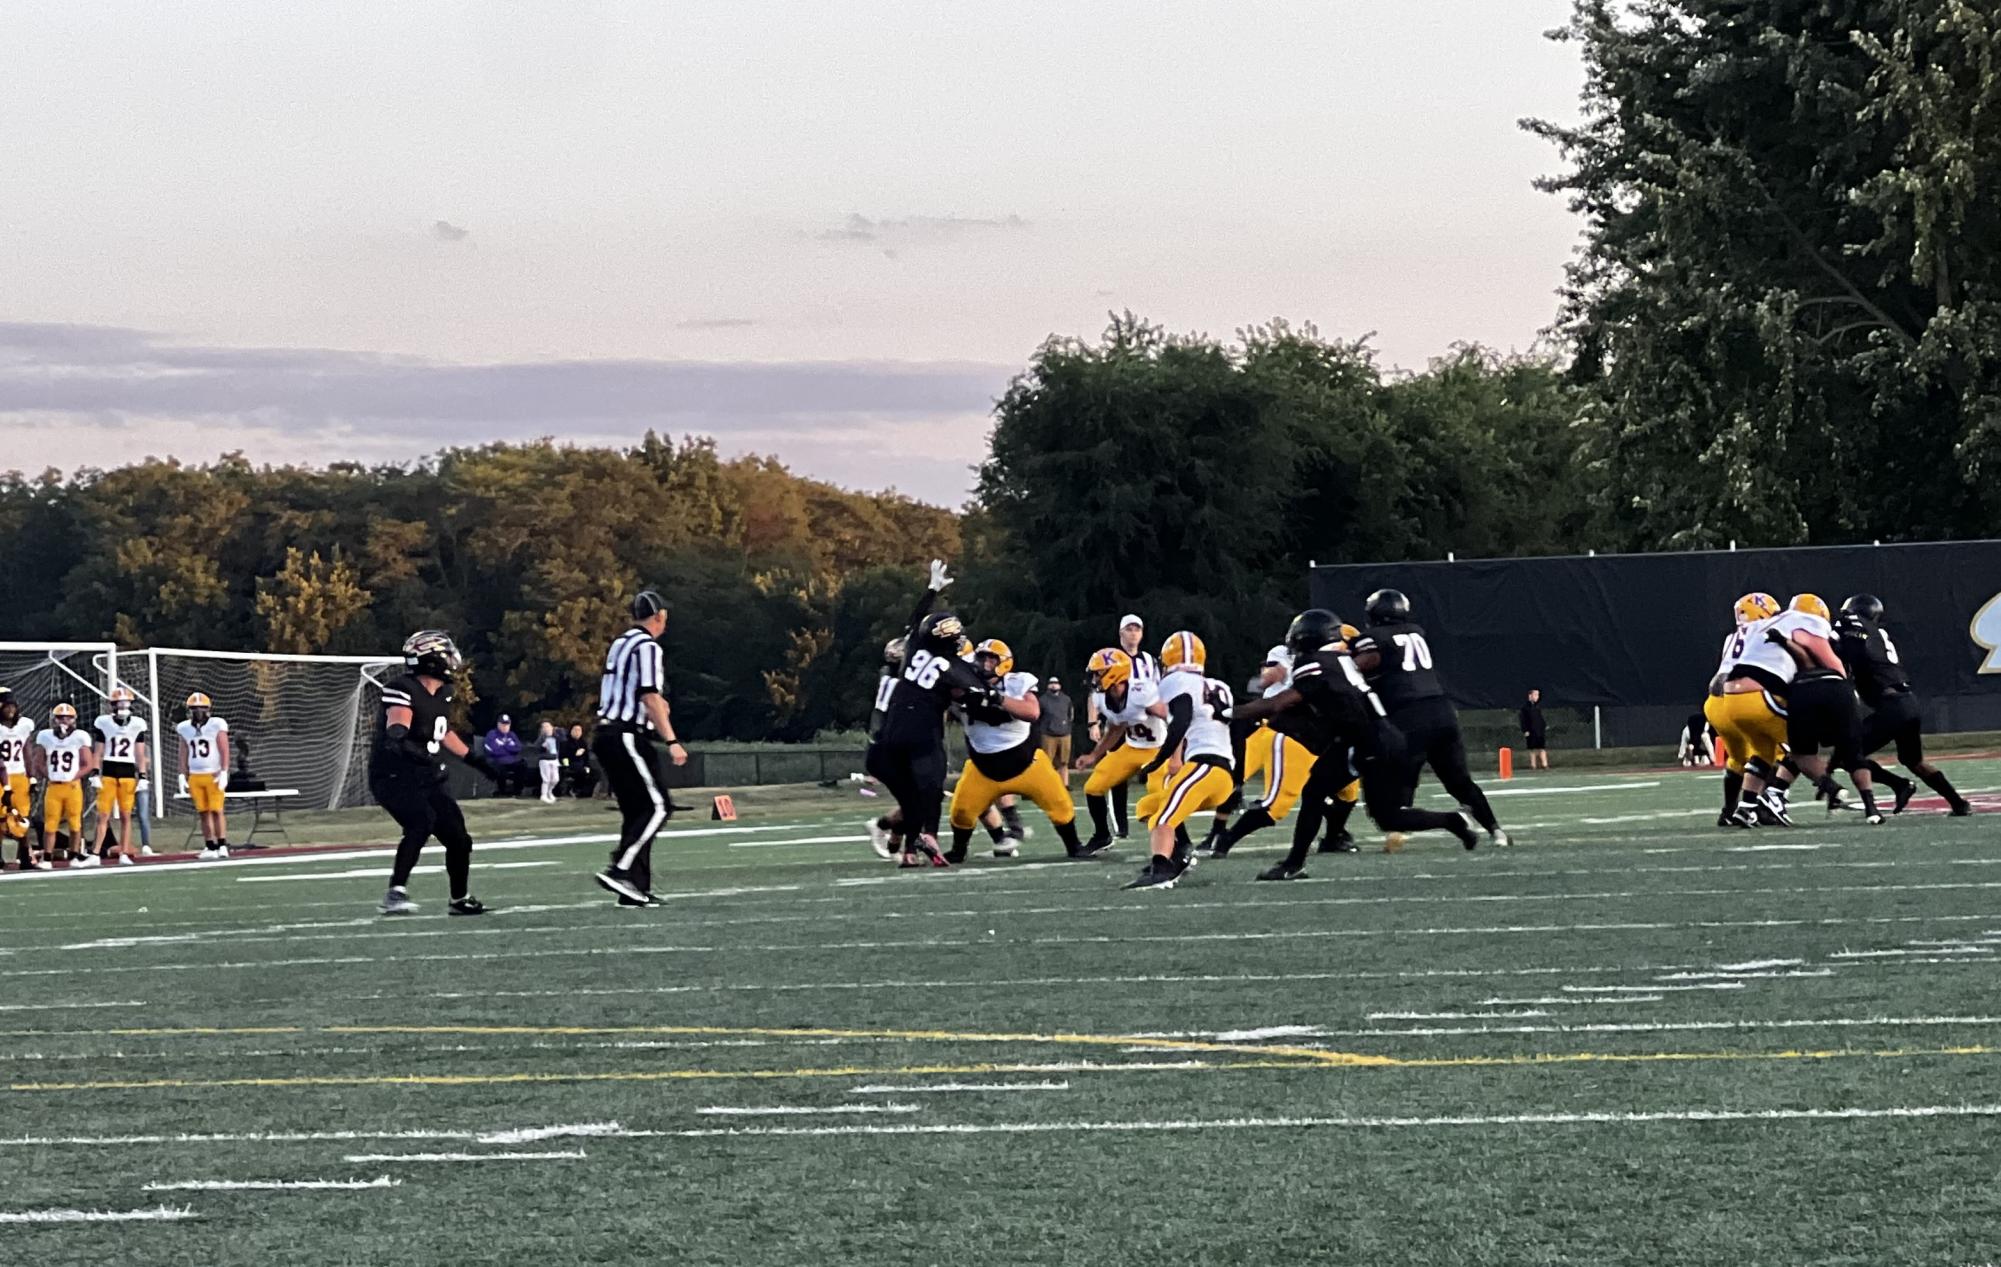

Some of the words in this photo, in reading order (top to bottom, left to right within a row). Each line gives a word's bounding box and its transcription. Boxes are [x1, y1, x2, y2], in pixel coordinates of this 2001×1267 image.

[1102, 651, 1115, 666] K
[1392, 633, 1432, 671] 70
[905, 649, 950, 689] 96
[110, 737, 131, 757] 12
[189, 739, 210, 758] 13
[50, 750, 74, 772] 49
